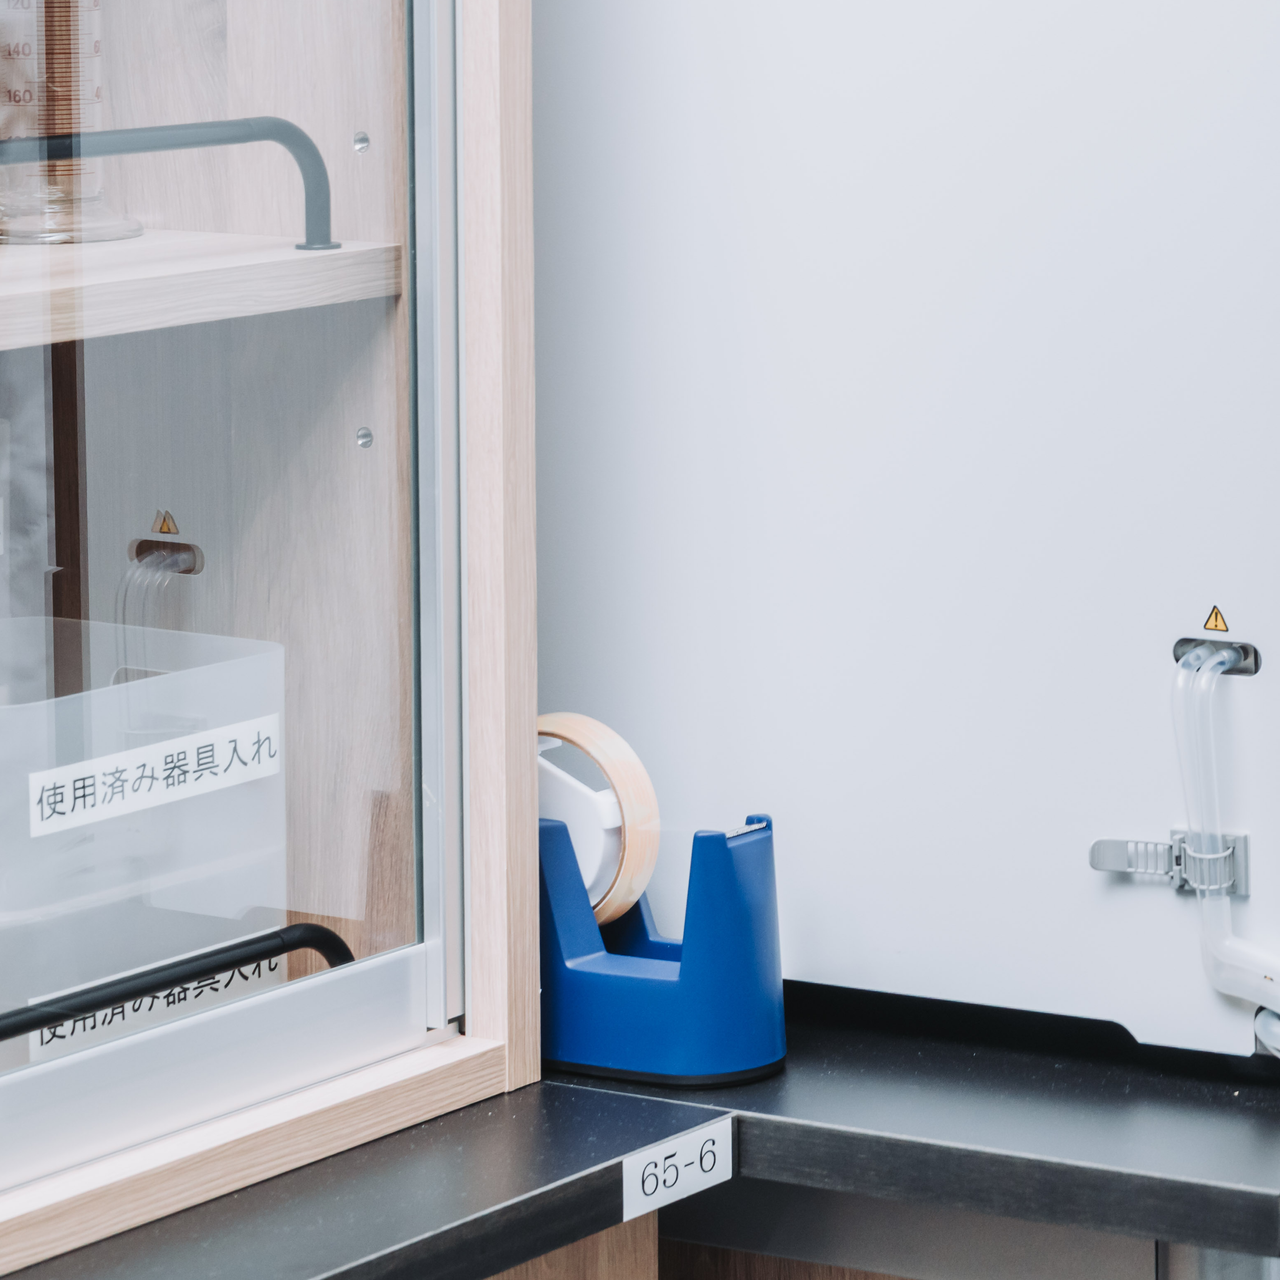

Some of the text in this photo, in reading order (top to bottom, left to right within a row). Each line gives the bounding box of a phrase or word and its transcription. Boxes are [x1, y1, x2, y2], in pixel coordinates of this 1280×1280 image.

[7, 42, 32, 57] 140
[7, 89, 33, 104] 160
[37, 731, 277, 821] 使用済み器具入れ
[641, 1138, 717, 1197] 65-6
